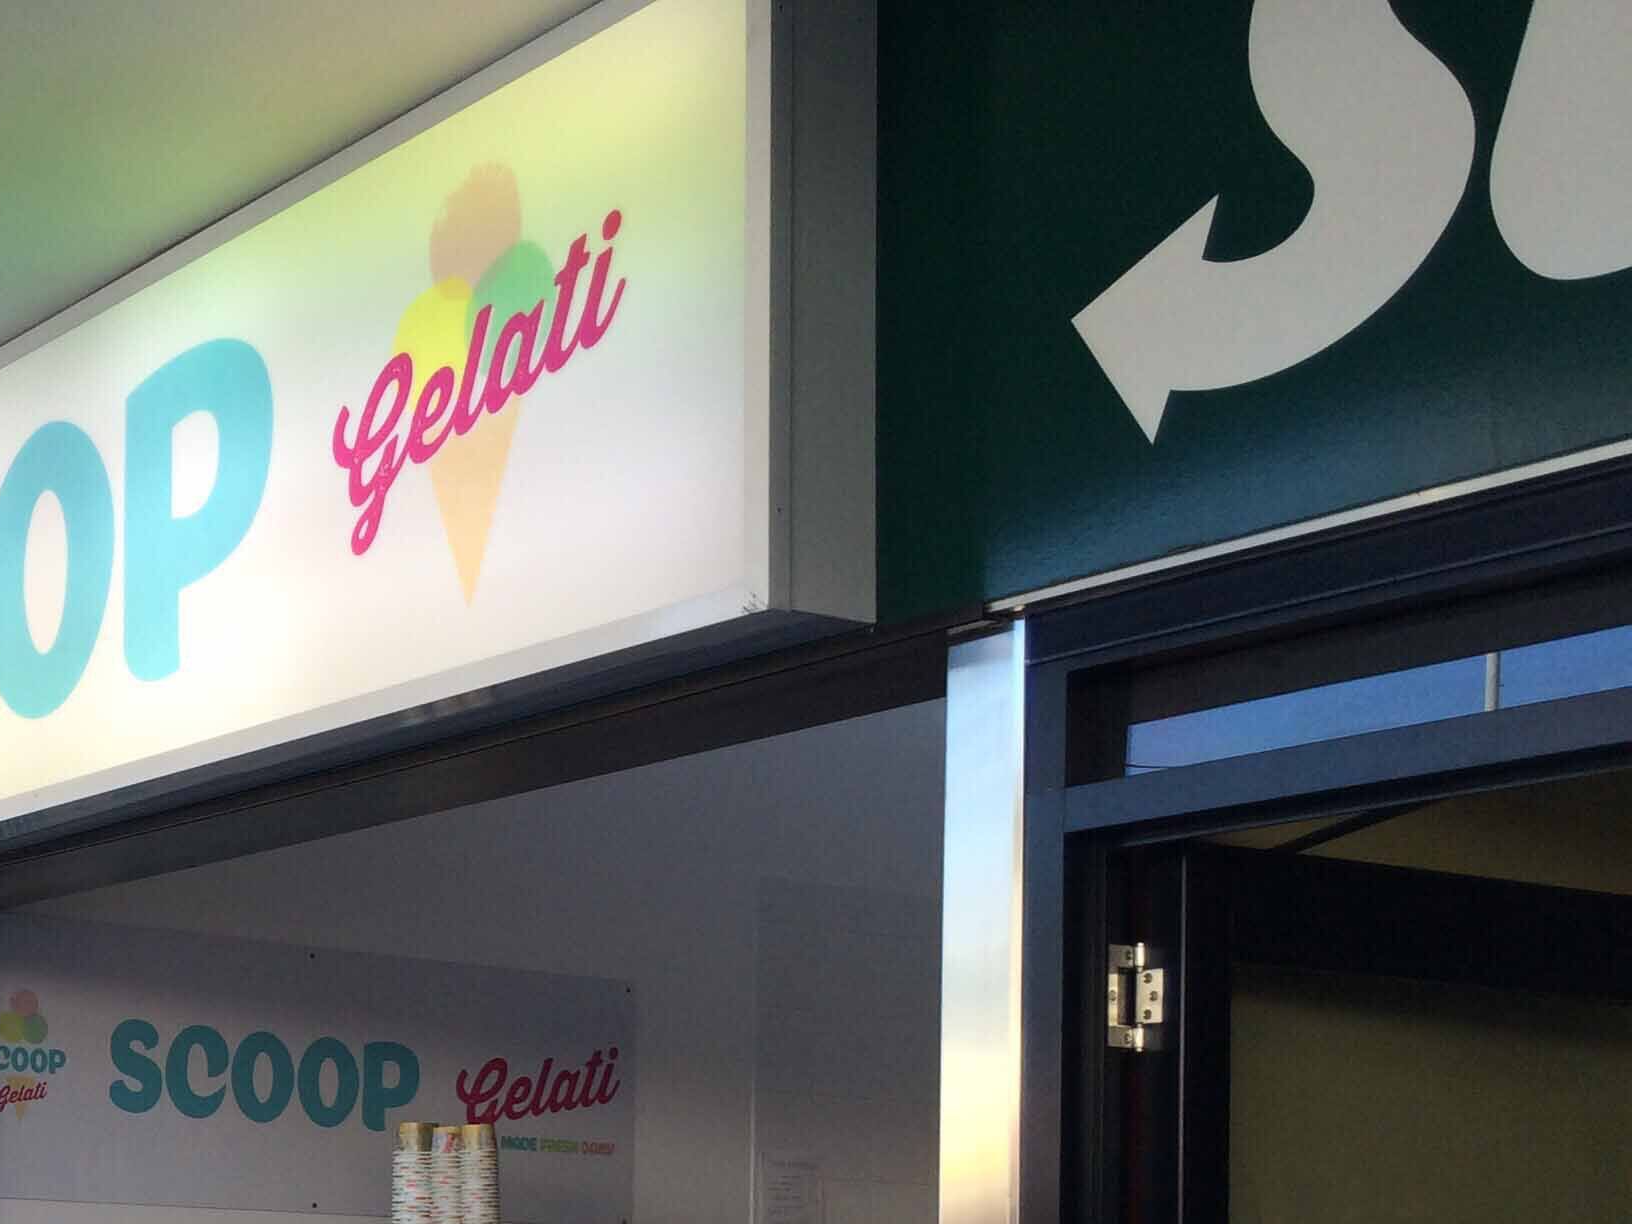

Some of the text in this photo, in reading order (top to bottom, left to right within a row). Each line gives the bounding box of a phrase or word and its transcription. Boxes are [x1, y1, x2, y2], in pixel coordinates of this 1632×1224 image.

[332, 209, 626, 557] Gelati
[109, 1018, 620, 1131] SCOOP Gelati
